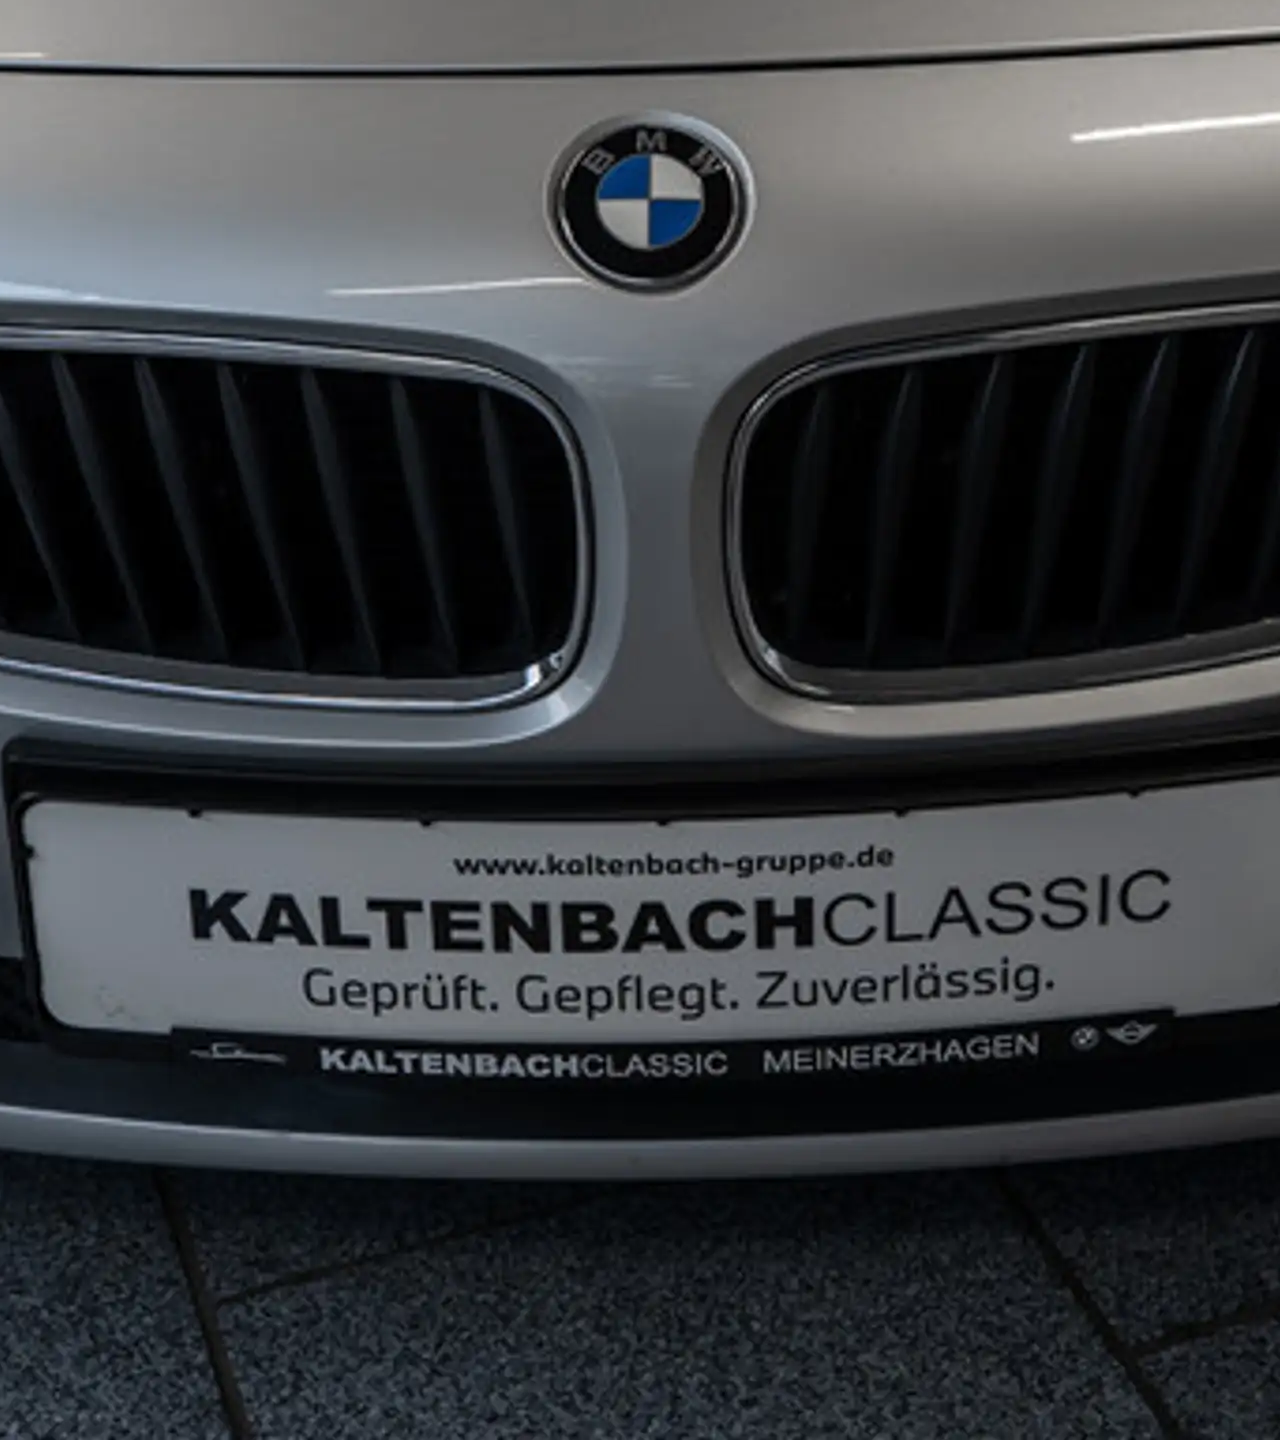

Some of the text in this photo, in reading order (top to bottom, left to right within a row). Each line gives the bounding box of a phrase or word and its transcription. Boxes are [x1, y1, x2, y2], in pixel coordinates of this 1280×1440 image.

[580, 129, 723, 177] BMW
[454, 844, 895, 879] www.kaltenbach-gruppe.de
[189, 869, 1171, 955] KALTENBACHCLASSIC
[303, 956, 1056, 1021] Geprüft. Gepflegt. Zuverlässig.
[320, 1032, 1040, 1078] KALTENBACHCLASSIC MEINERZHAGEN
